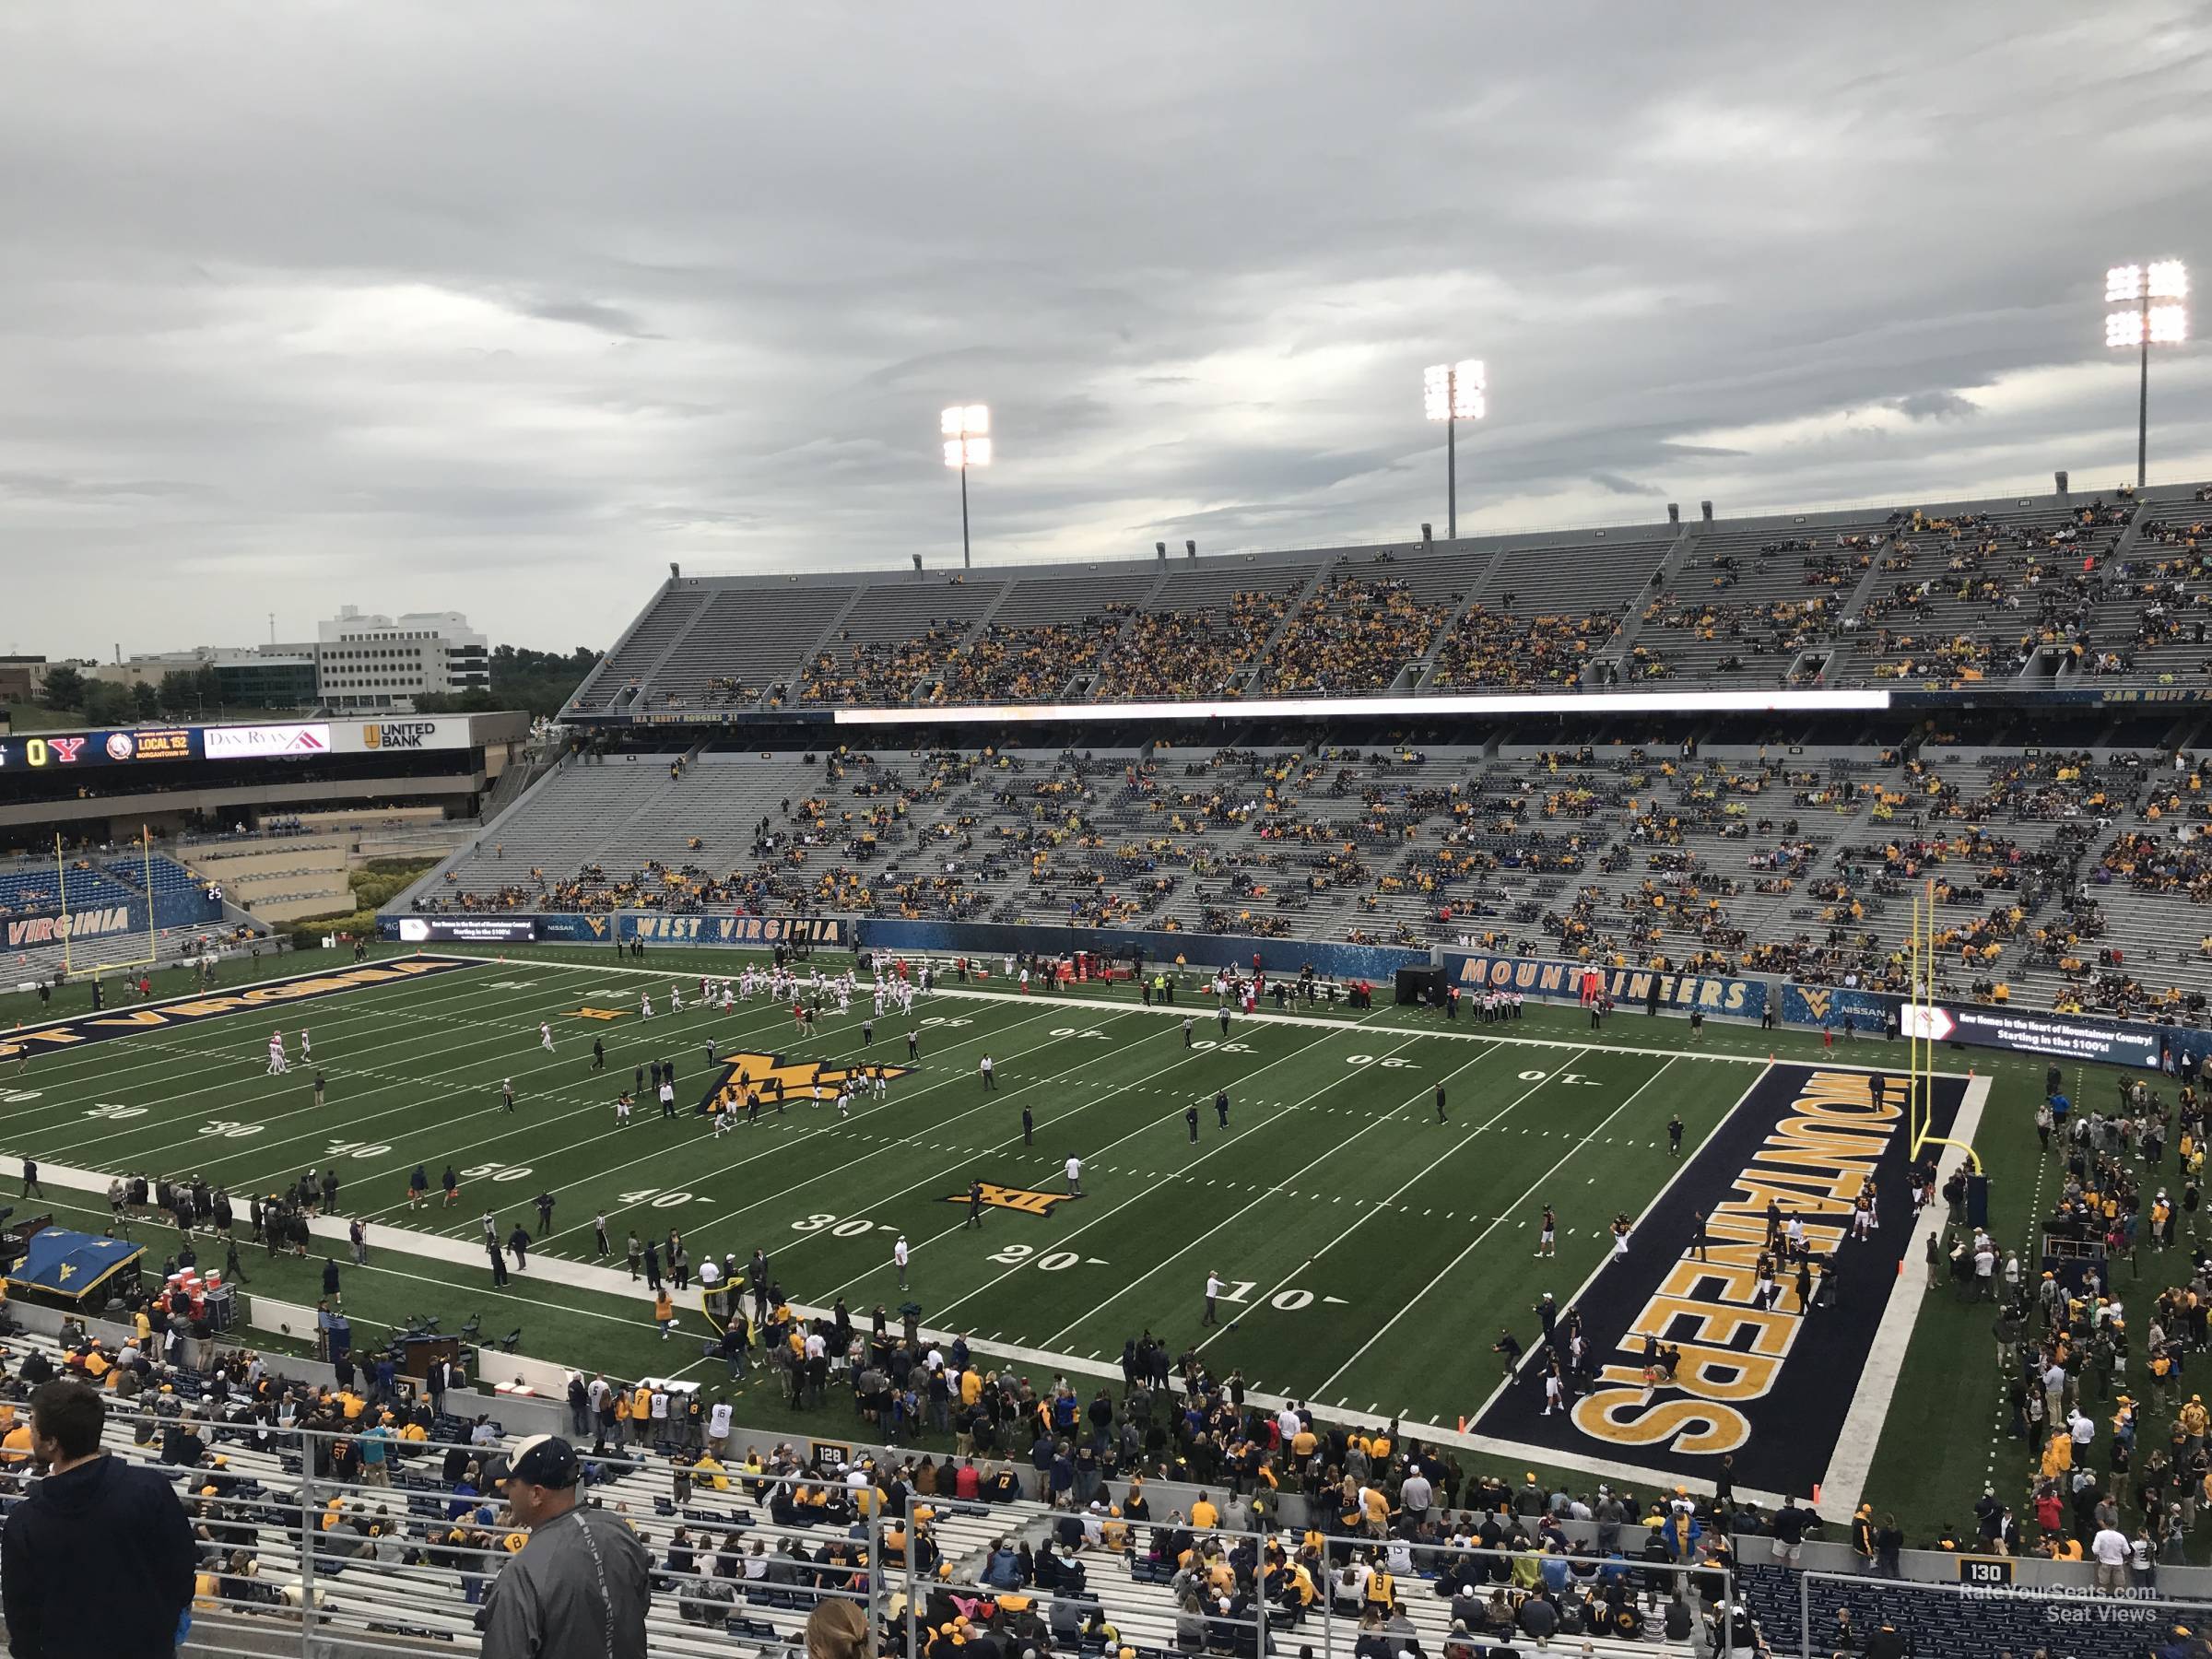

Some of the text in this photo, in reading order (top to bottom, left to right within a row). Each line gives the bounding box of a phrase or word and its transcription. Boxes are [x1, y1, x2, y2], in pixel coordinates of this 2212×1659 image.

[2102, 690, 2138, 701] SAM
[382, 723, 435, 735] UNITED
[139, 735, 187, 751] LOCAL 152
[382, 735, 422, 747] BANK
[26, 738, 46, 766] 0
[48, 738, 84, 762] Y
[208, 888, 221, 900] 25
[8, 907, 128, 946] VIRGINIA
[637, 916, 839, 942] WEST VIRGINIA
[1460, 958, 1747, 1010] MOUNTAINEERS
[1841, 1006, 1886, 1018] NISSAN
[1959, 1013, 2152, 1045] New Homes in the Heart of Mountaineer Country!
[1998, 1030, 2039, 1045] Starting
[2041, 1037, 2051, 1045] in
[2054, 1038, 2070, 1048] the
[324, 1142, 392, 1159] 40
[460, 1162, 533, 1182] 50
[618, 1188, 693, 1207] 40
[791, 1214, 875, 1237] 30
[985, 1244, 1079, 1271] 20
[1571, 1071, 1919, 1455] MOUNTAINEERS
[1215, 1280, 1314, 1311] 10
[593, 1385, 599, 1395] 5
[637, 1395, 643, 1406] 7
[655, 1397, 662, 1406] 8
[717, 1408, 726, 1418] 16
[333, 1449, 347, 1461] 67
[819, 1447, 841, 1462] 128
[998, 1476, 1010, 1489] 12
[1342, 1496, 1358, 1508] 67
[512, 1535, 522, 1549] 8
[1971, 1564, 2001, 1582] 130
[1375, 1577, 1383, 1591] 8
[1513, 1594, 1525, 1609] 17
[1594, 1607, 1606, 1622] 17
